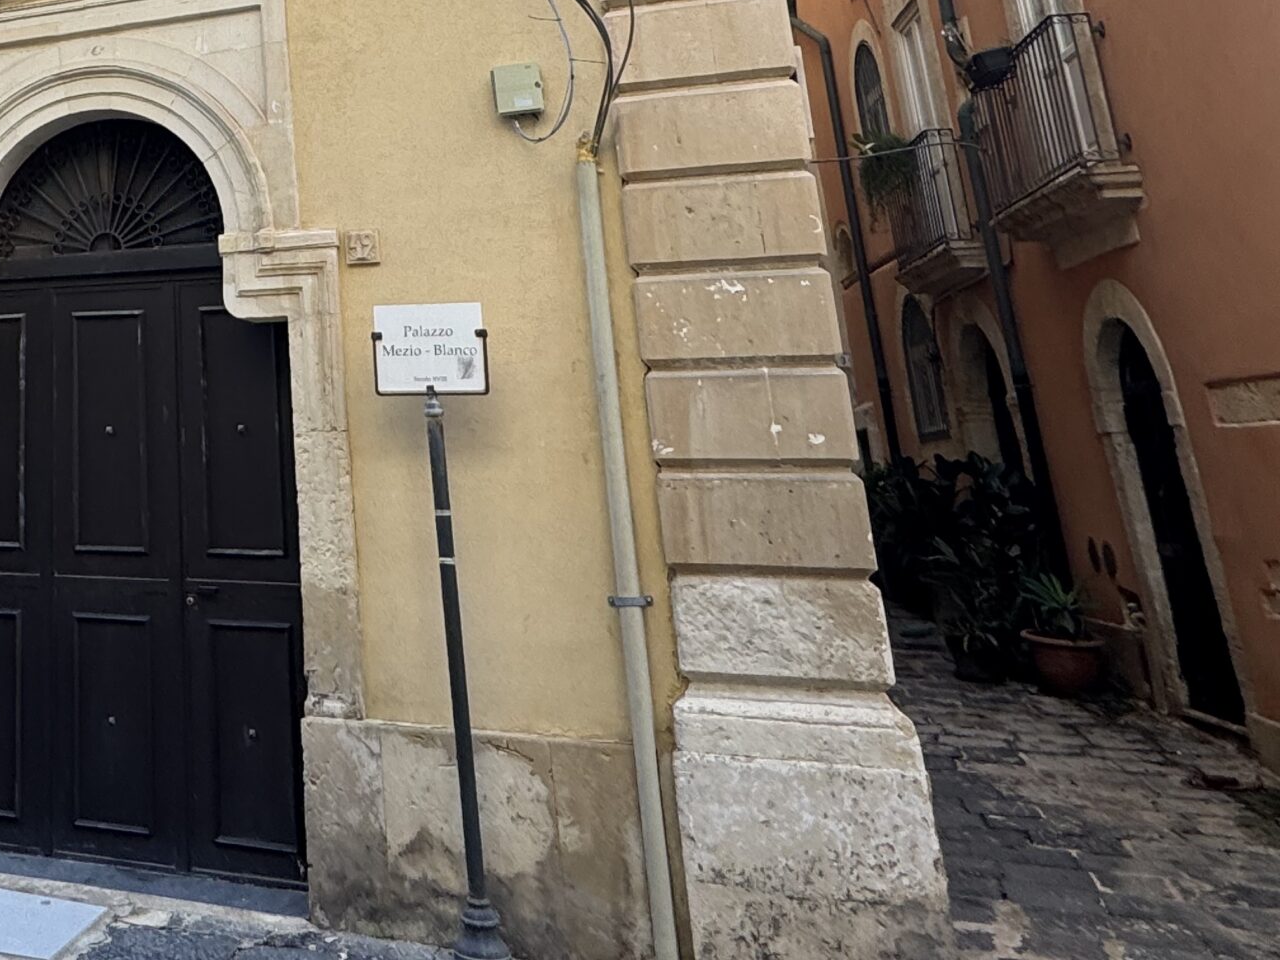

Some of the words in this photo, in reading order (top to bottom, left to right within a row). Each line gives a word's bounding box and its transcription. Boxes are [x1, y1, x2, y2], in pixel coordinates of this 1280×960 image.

[403, 325, 454, 338] Palazzo
[382, 344, 422, 357] Mezio
[433, 344, 478, 356] Blanco
